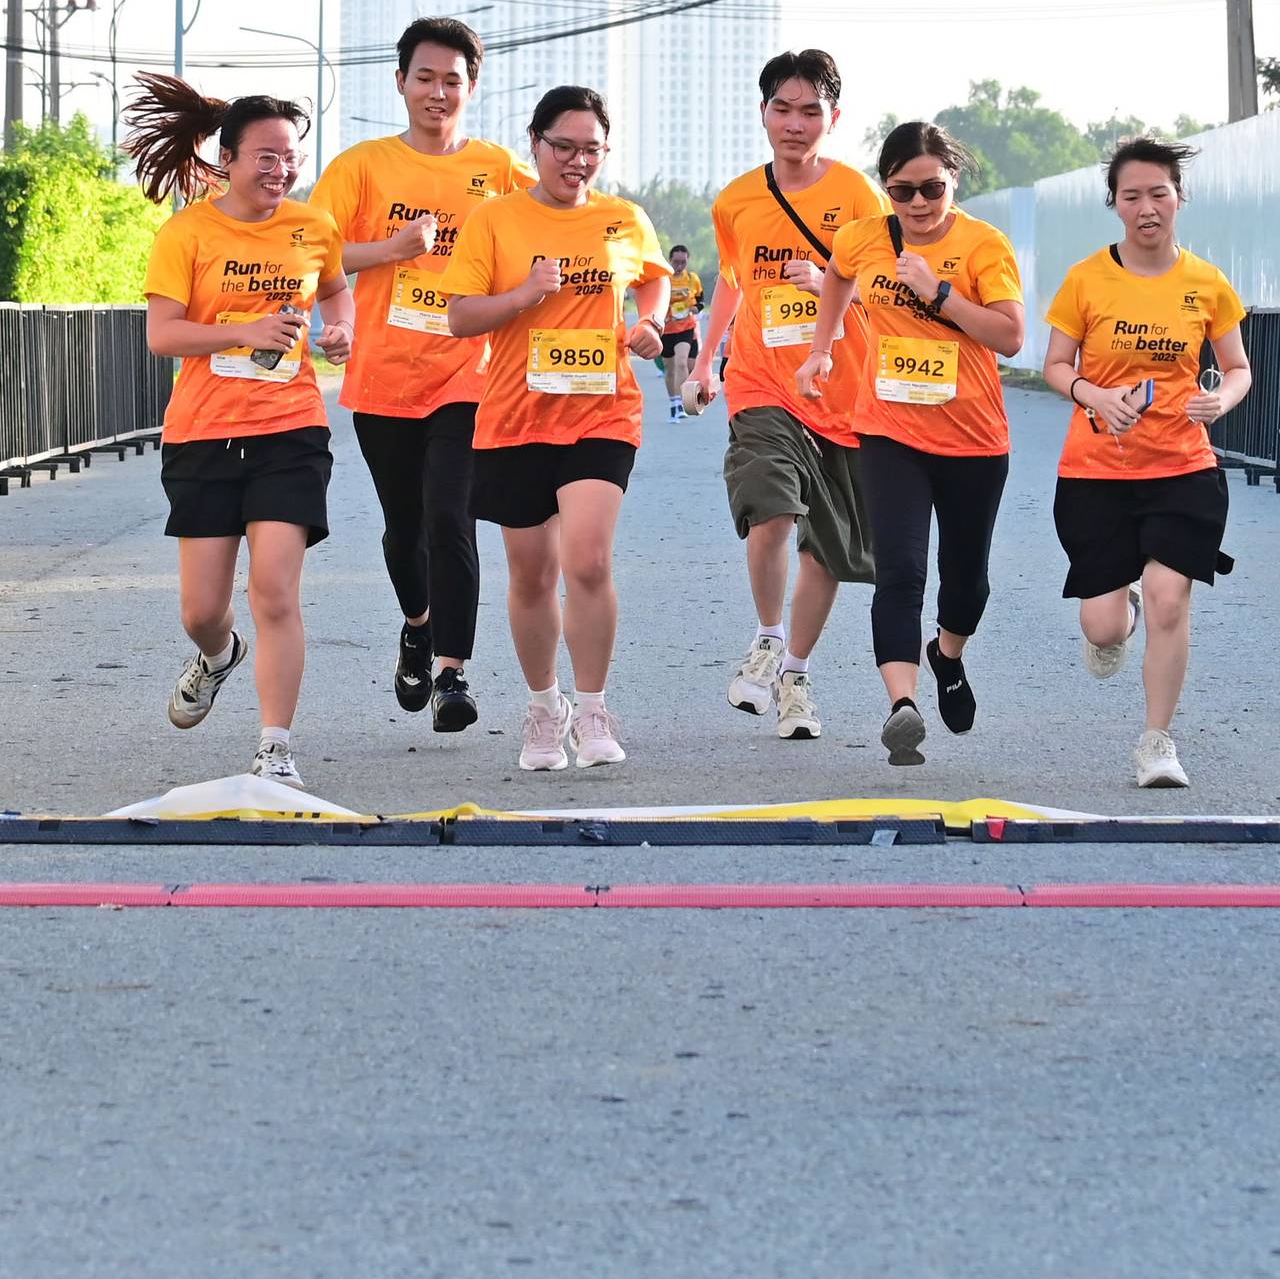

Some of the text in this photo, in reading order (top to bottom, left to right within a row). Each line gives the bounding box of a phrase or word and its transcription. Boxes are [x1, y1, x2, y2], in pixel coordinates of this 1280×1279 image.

[433, 209, 456, 223] for
[386, 224, 400, 239] th
[572, 254, 595, 268] for
[753, 245, 813, 263] Run for
[223, 260, 284, 277] Run for
[559, 267, 616, 286] better
[752, 265, 777, 281] the
[221, 275, 305, 294] the better
[574, 283, 605, 296] 2025
[871, 274, 911, 295] Run
[265, 291, 294, 302] 2025
[868, 291, 890, 305] the
[780, 300, 818, 320] 998
[1113, 320, 1169, 336] Run for
[1111, 335, 1188, 353] the better
[549, 348, 605, 366] 9850
[1151, 352, 1178, 363] 2025
[894, 356, 945, 377] 9942
